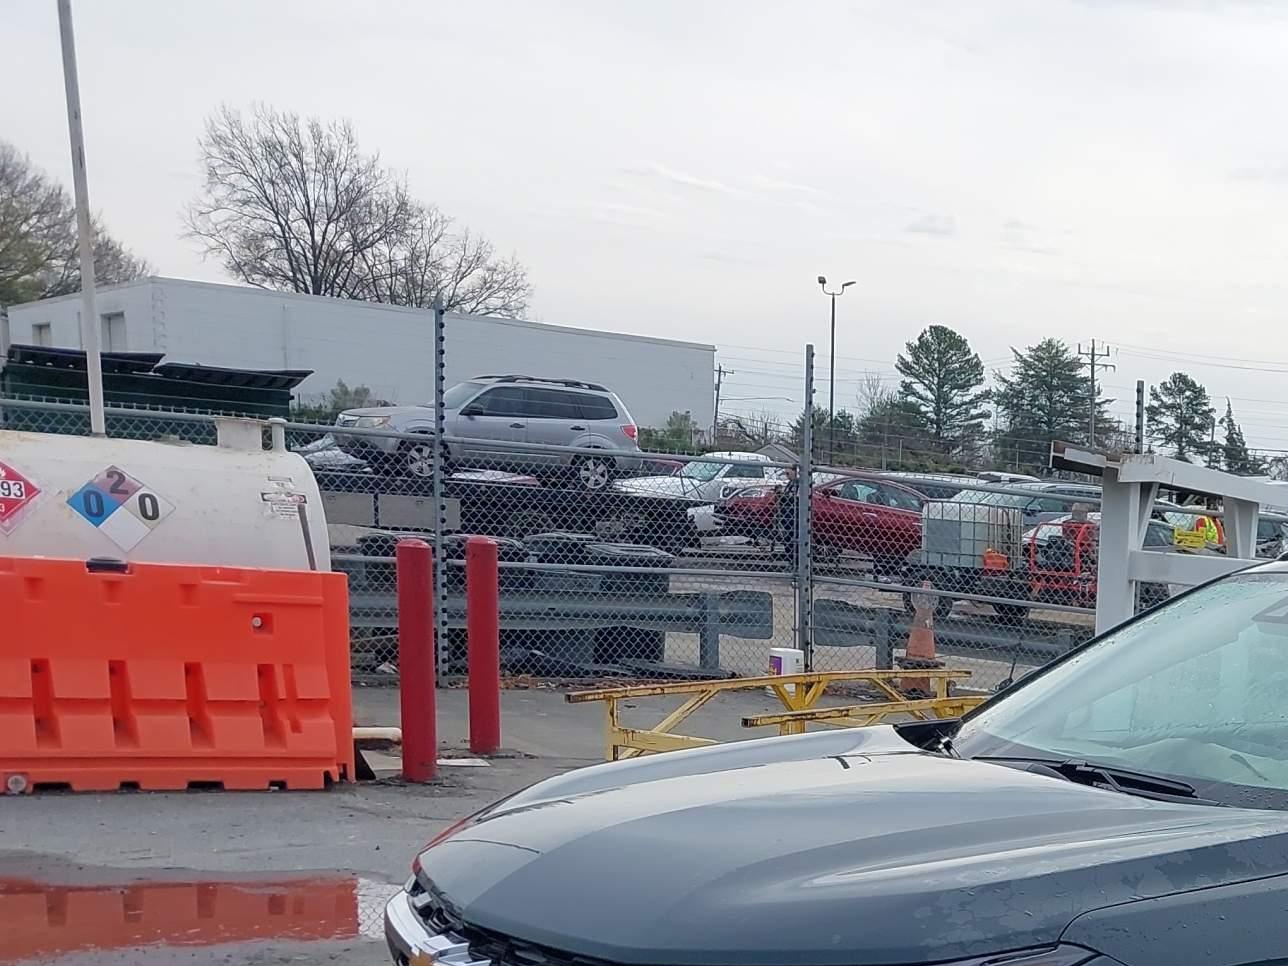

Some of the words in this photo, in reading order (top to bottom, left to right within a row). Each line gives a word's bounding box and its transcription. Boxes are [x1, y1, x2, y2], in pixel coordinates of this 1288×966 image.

[106, 470, 129, 494] 2
[83, 490, 105, 518] 0
[138, 493, 160, 520] 0
